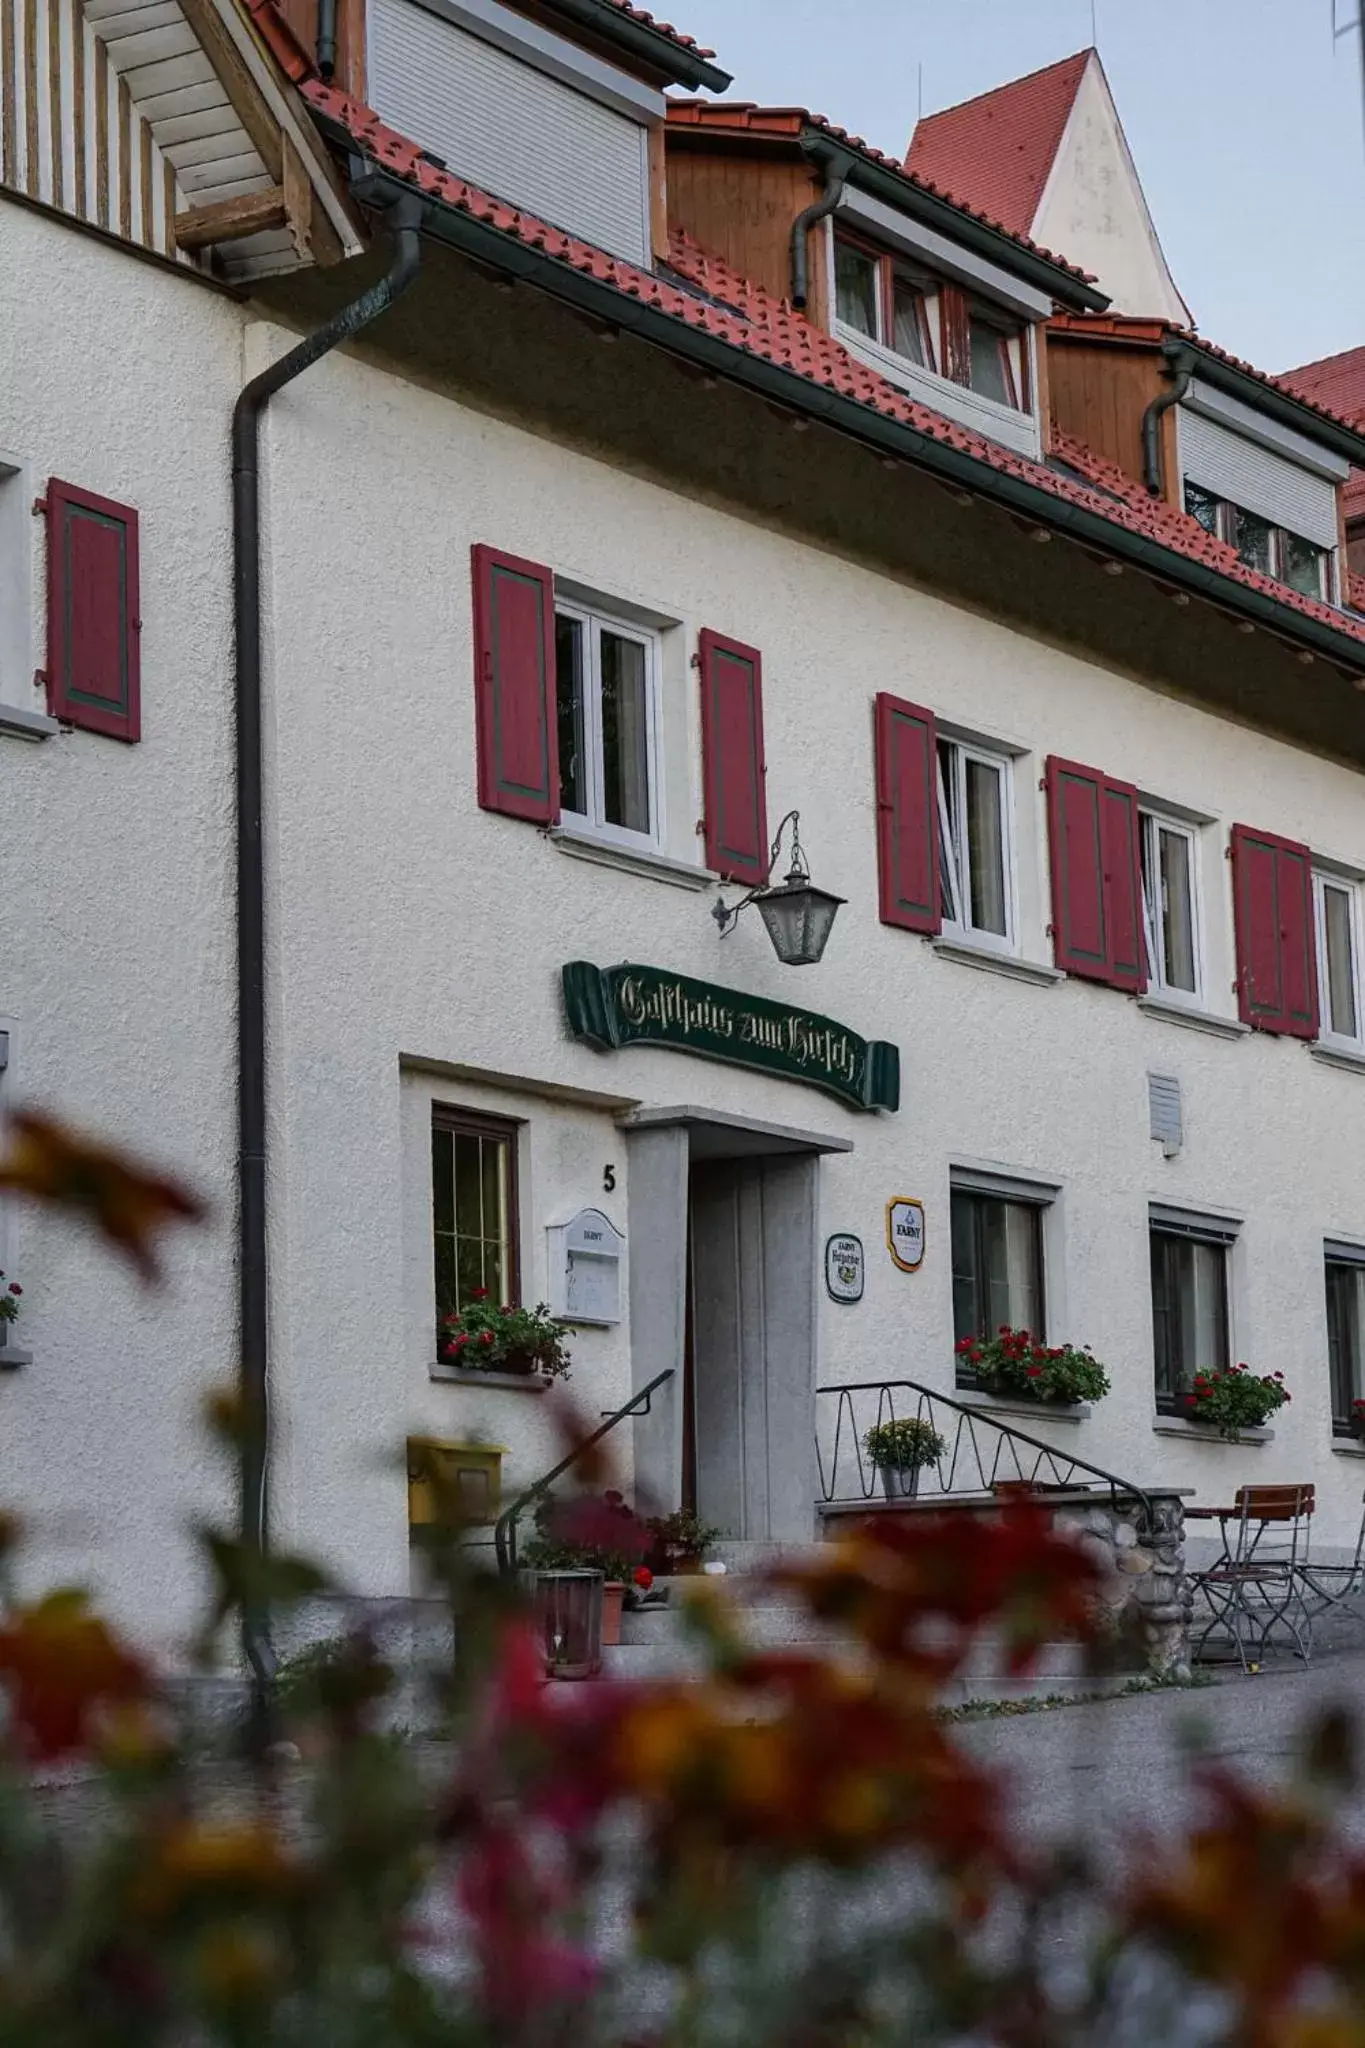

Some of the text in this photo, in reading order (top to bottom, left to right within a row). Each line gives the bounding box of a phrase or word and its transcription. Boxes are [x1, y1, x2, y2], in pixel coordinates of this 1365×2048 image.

[737, 1012, 783, 1051] zum
[603, 1164, 616, 1193] 5
[896, 1224, 921, 1239] FARNY
